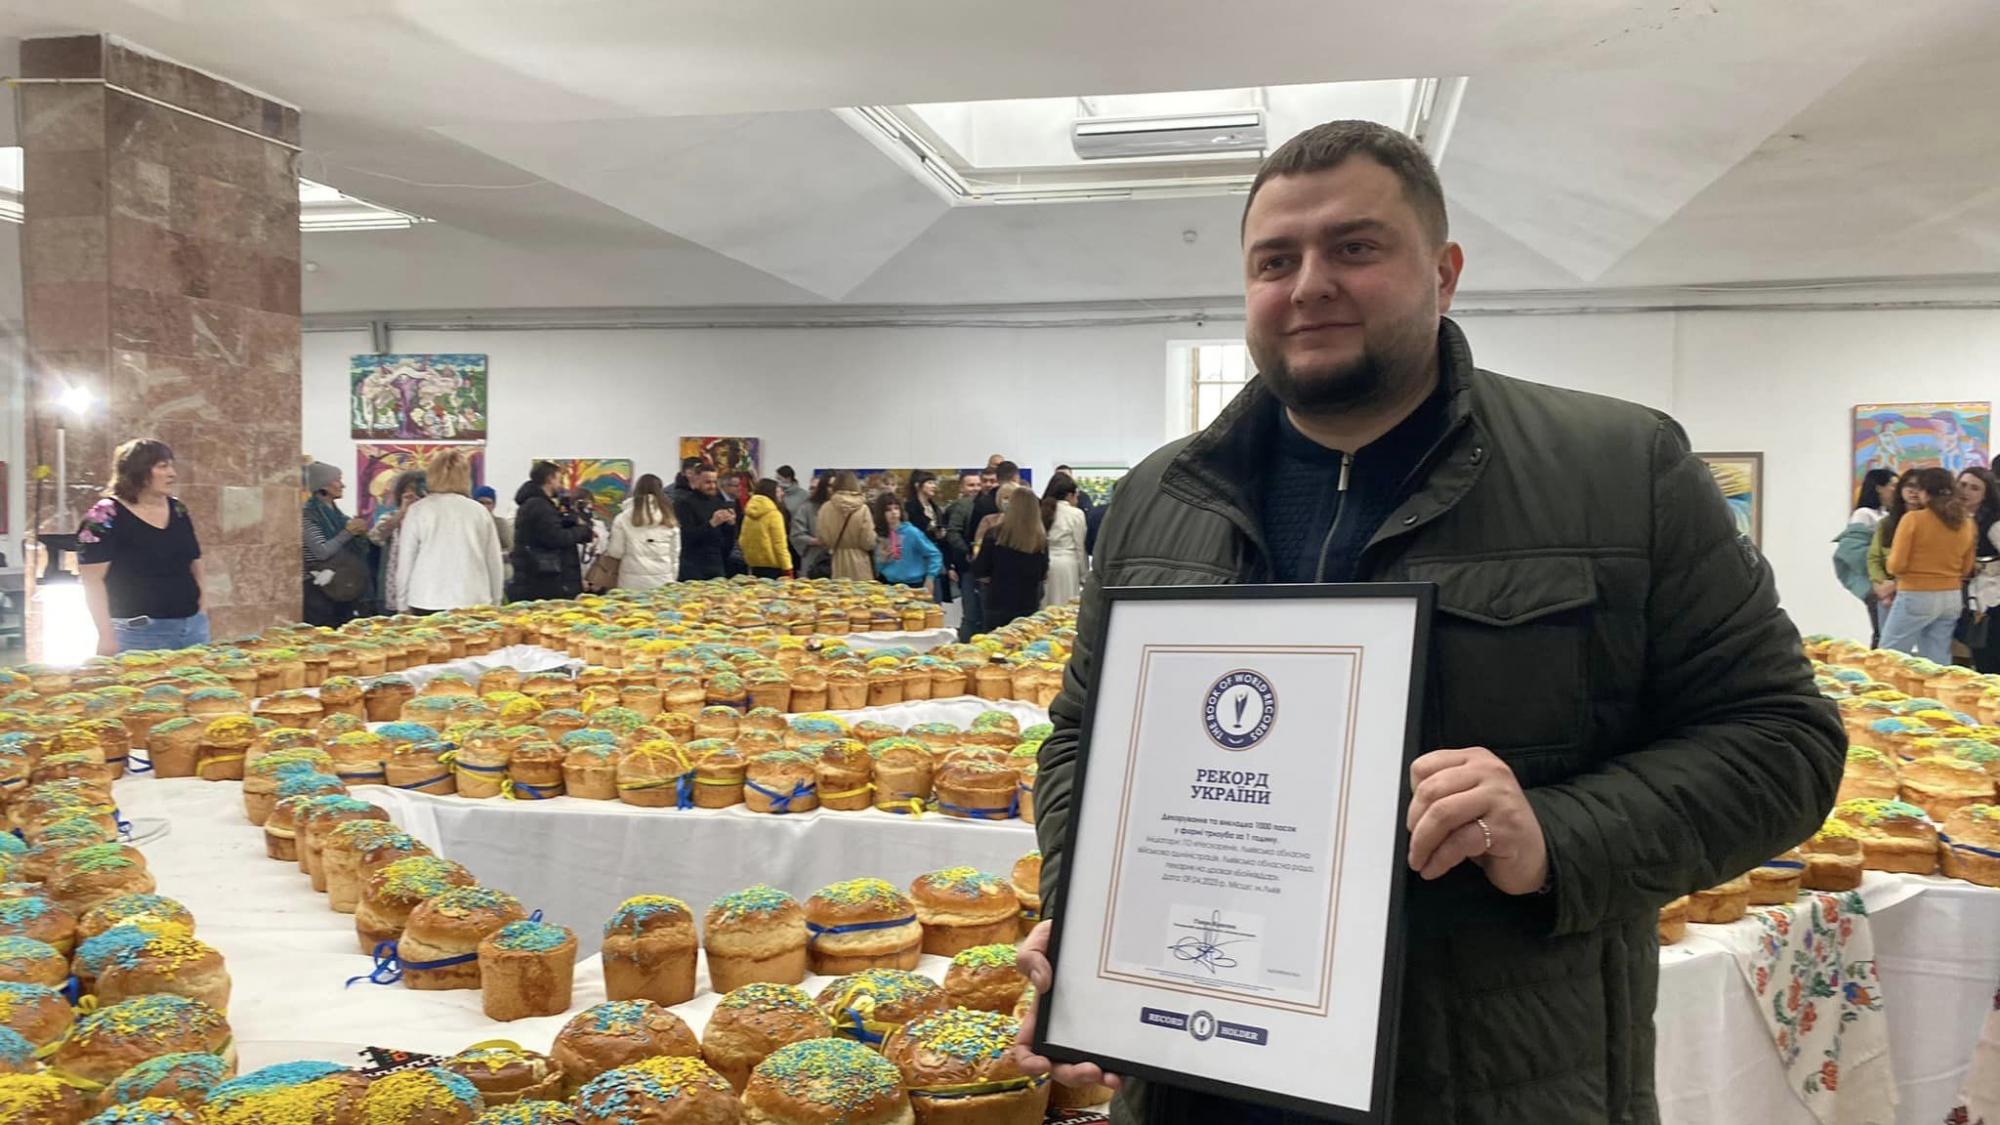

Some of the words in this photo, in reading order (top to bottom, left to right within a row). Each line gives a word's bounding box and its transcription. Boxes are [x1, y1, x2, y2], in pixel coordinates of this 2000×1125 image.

[1218, 676, 1233, 690] OF
[1235, 674, 1268, 692] WORLD
[1206, 690, 1221, 721] BOOK
[1250, 692, 1274, 741] RECORDS
[1196, 769, 1269, 789] РЕКОРД
[1191, 785, 1272, 805] УКРАЇНИ
[1148, 1013, 1185, 1026] RECORD
[1220, 1026, 1259, 1040] HOLDER
